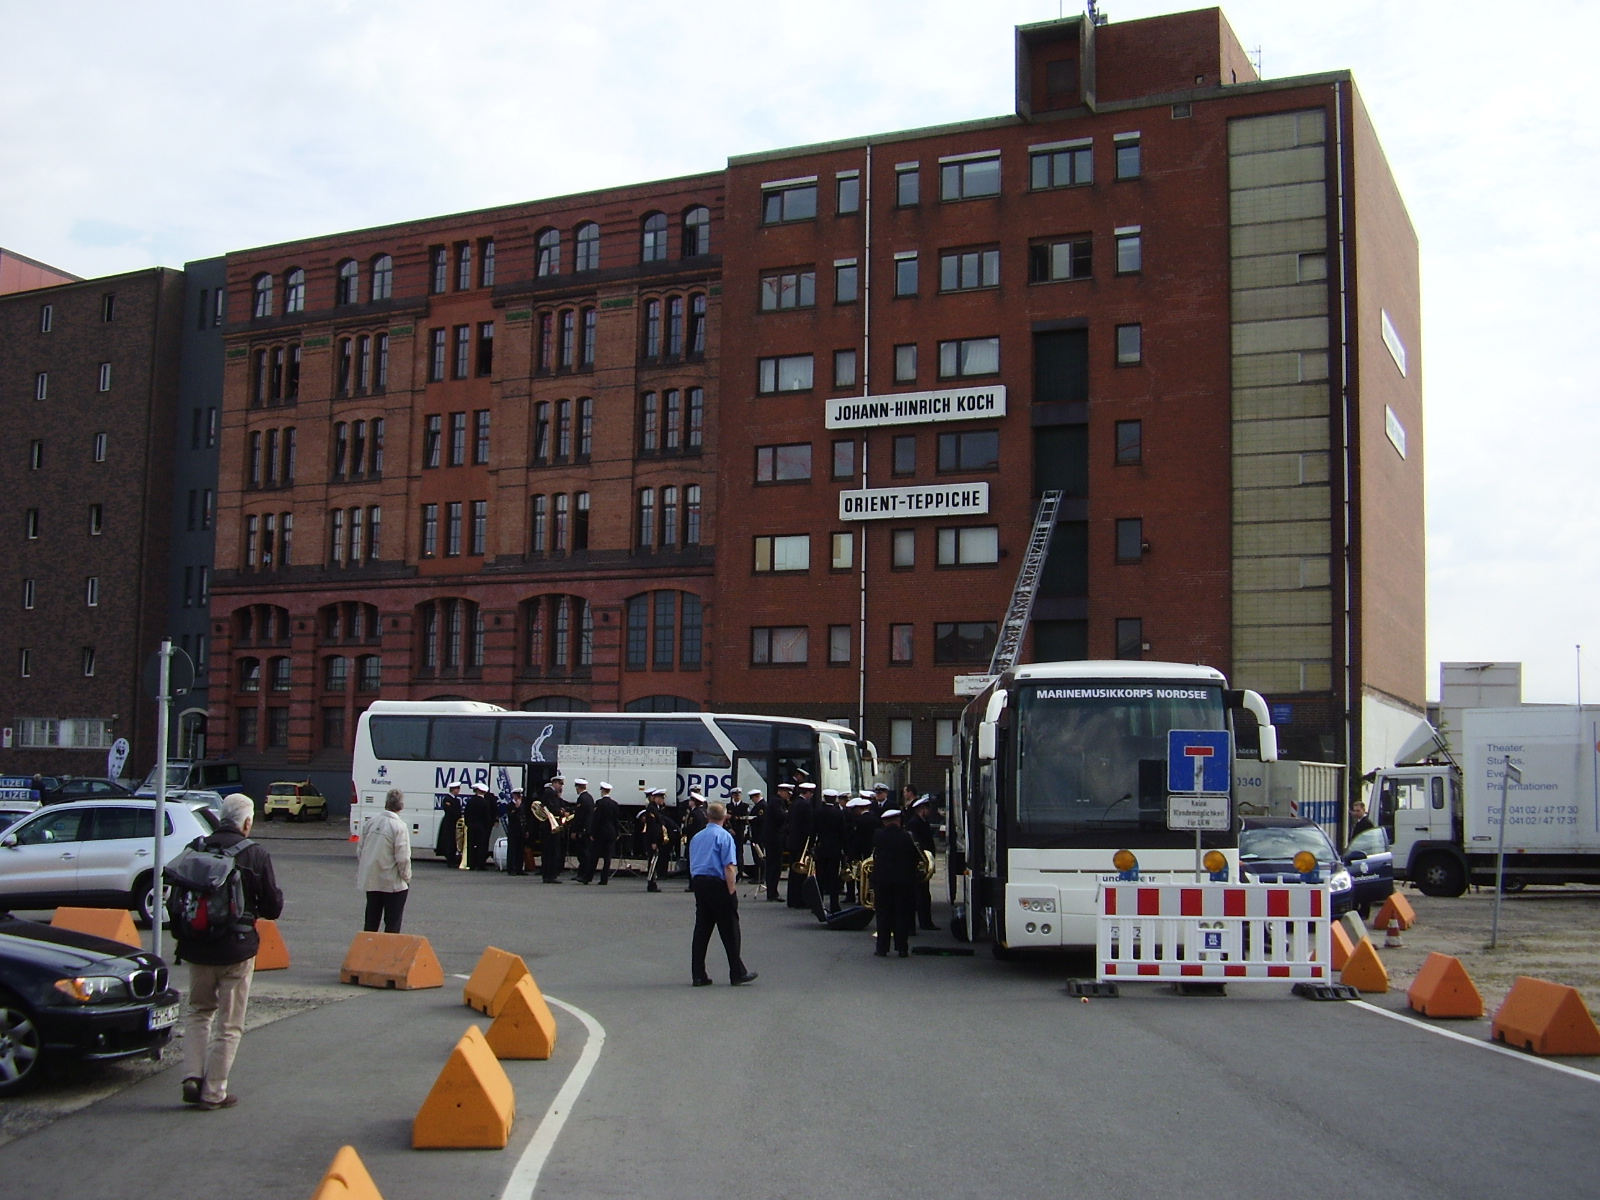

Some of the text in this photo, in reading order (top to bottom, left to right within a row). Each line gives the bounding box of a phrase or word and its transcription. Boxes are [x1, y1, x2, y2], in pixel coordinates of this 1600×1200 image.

[835, 393, 994, 421] JOHANN-HINRICH KOCH
[844, 490, 980, 513] ORIENT-TEPPICHE
[1036, 689, 1207, 700] MARINEMUSIKKORPS NORDSEE
[1487, 770, 1505, 778] Eve
[0, 779, 24, 787] LIZEI
[371, 778, 392, 786] Marine
[1487, 783, 1558, 791] Präentationen
